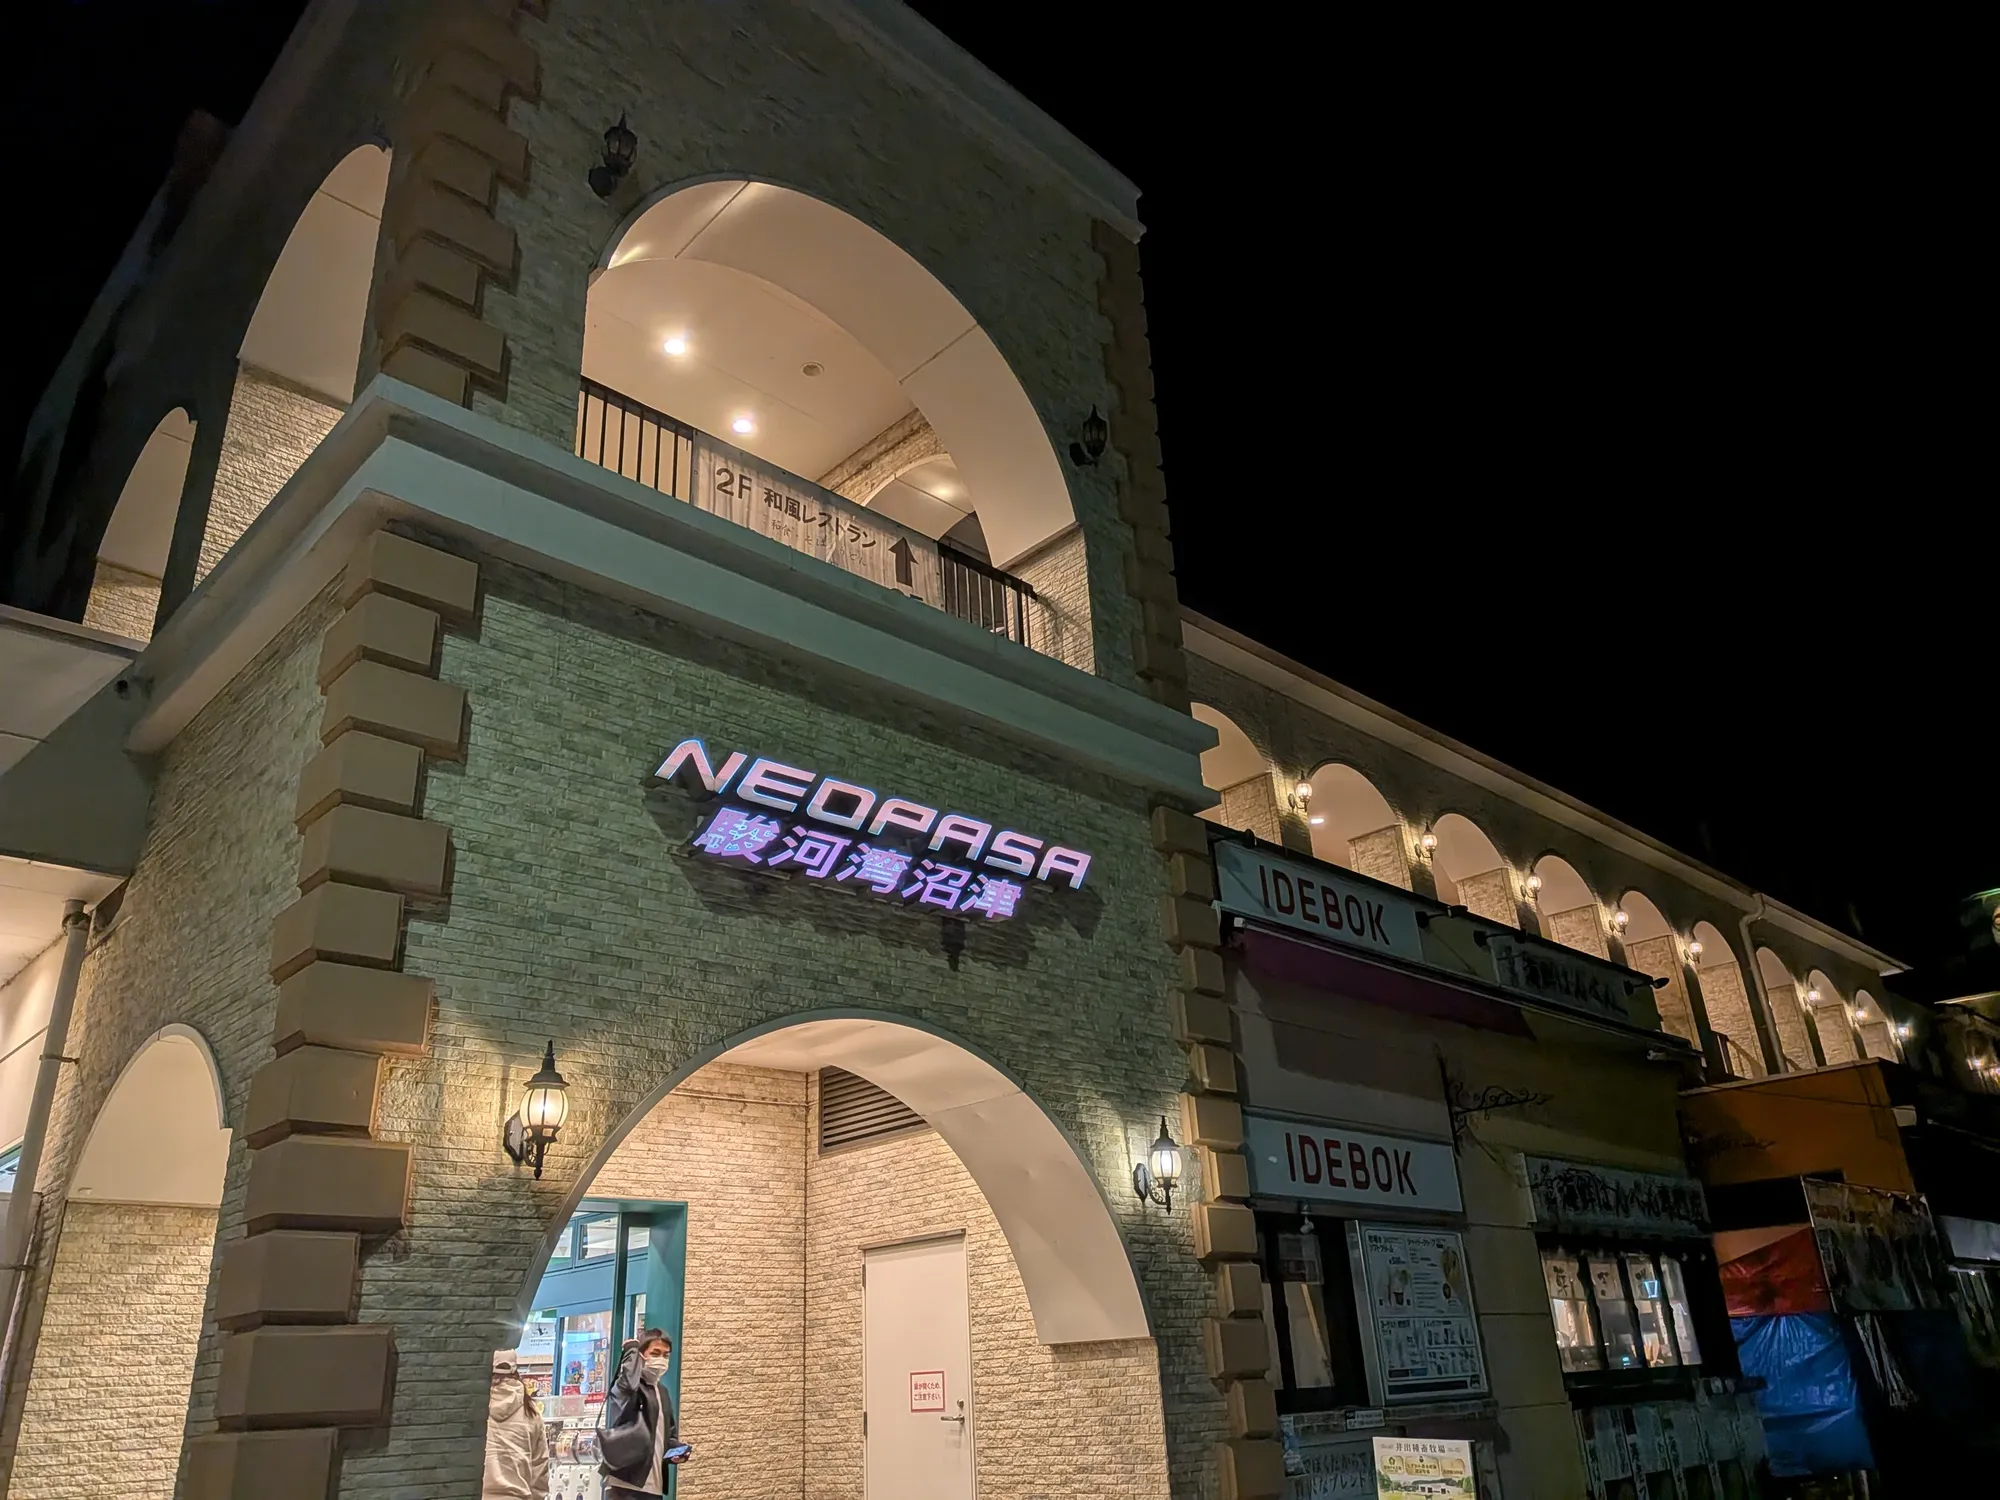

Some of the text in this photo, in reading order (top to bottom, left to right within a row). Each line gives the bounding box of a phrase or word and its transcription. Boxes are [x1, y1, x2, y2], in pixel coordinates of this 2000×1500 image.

[716, 467, 752, 499] 2F
[763, 486, 877, 549] 和風レストラン
[654, 737, 1092, 891] NEOPASA
[692, 807, 1022, 920] 駿河湾沼津
[1259, 863, 1391, 946] IDEBOK
[1284, 1132, 1419, 1197] IDEBOK
